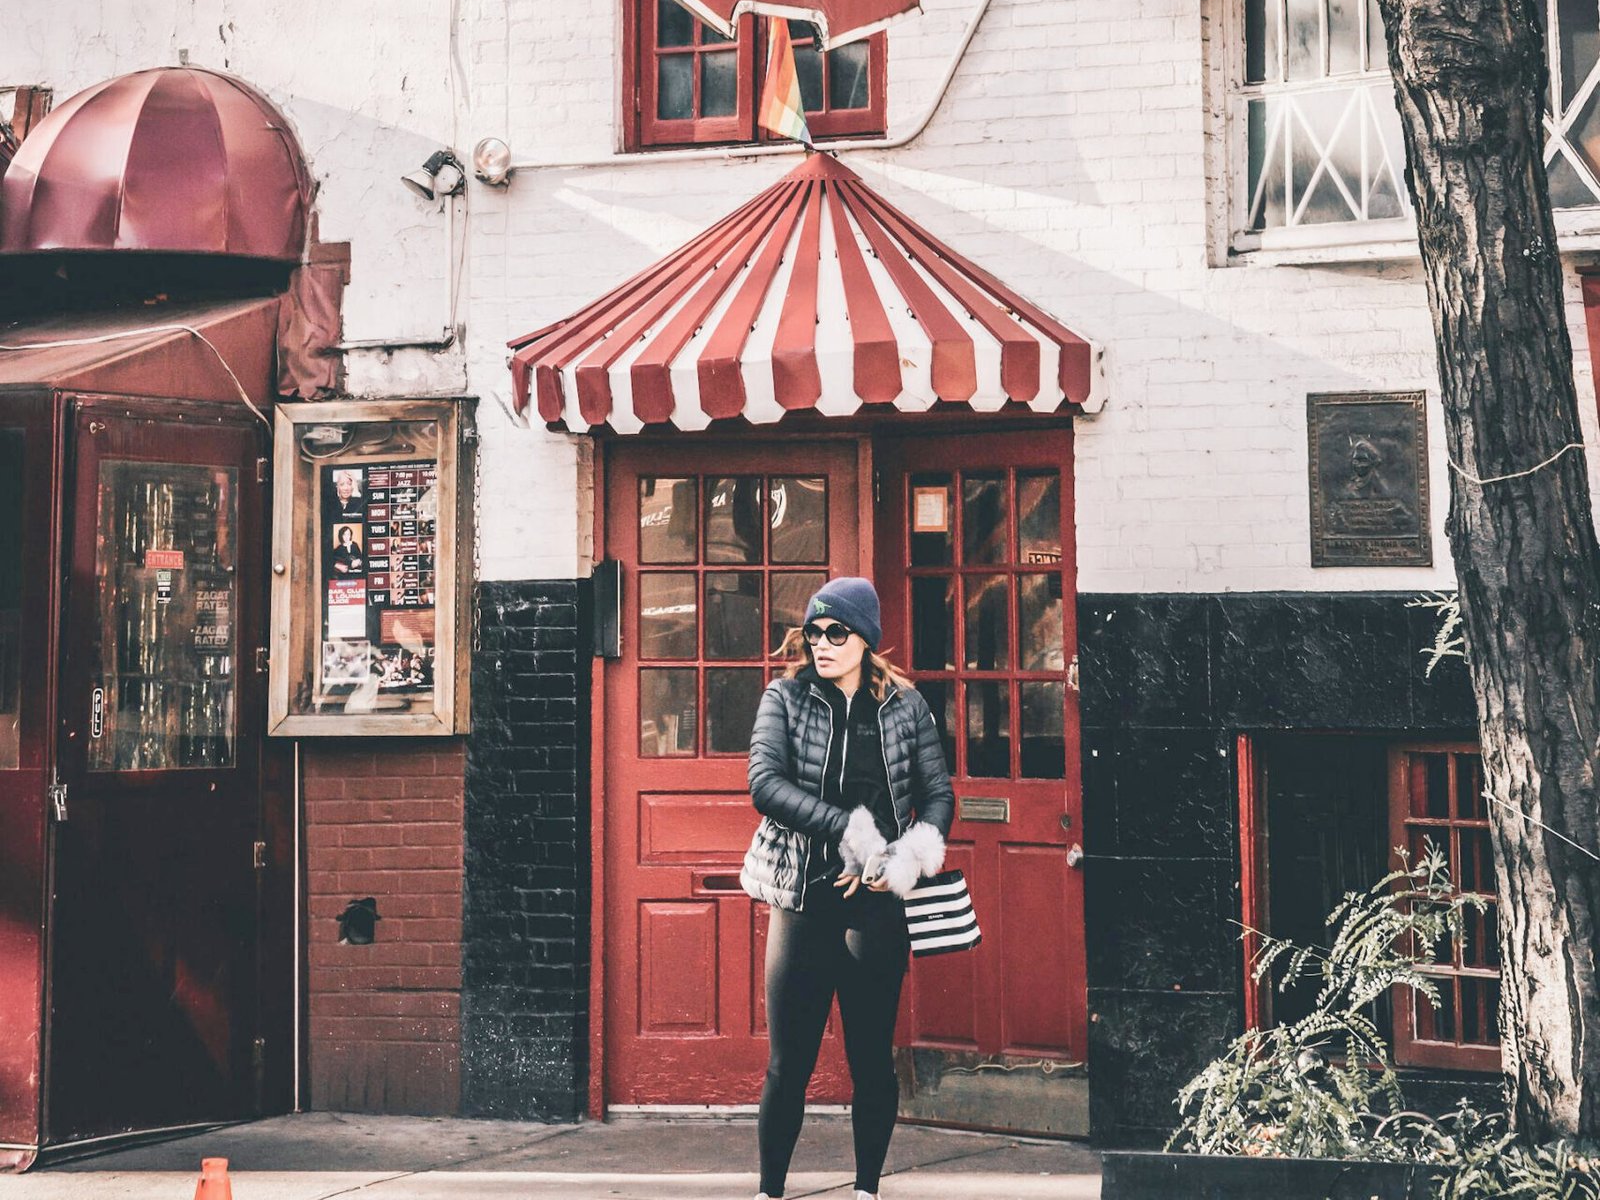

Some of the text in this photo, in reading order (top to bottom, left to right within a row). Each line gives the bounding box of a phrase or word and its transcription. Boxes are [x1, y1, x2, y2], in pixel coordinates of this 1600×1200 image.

[372, 492, 385, 500] SUN
[371, 543, 386, 551] WED
[147, 553, 183, 566] ENTRANCE
[368, 560, 389, 568] THURS
[374, 577, 384, 585] FRI
[196, 590, 230, 601] ZAGAT
[374, 594, 385, 602] SAT
[196, 600, 229, 611] RATED
[195, 625, 229, 636] ZAGAT
[194, 635, 229, 645] RATED
